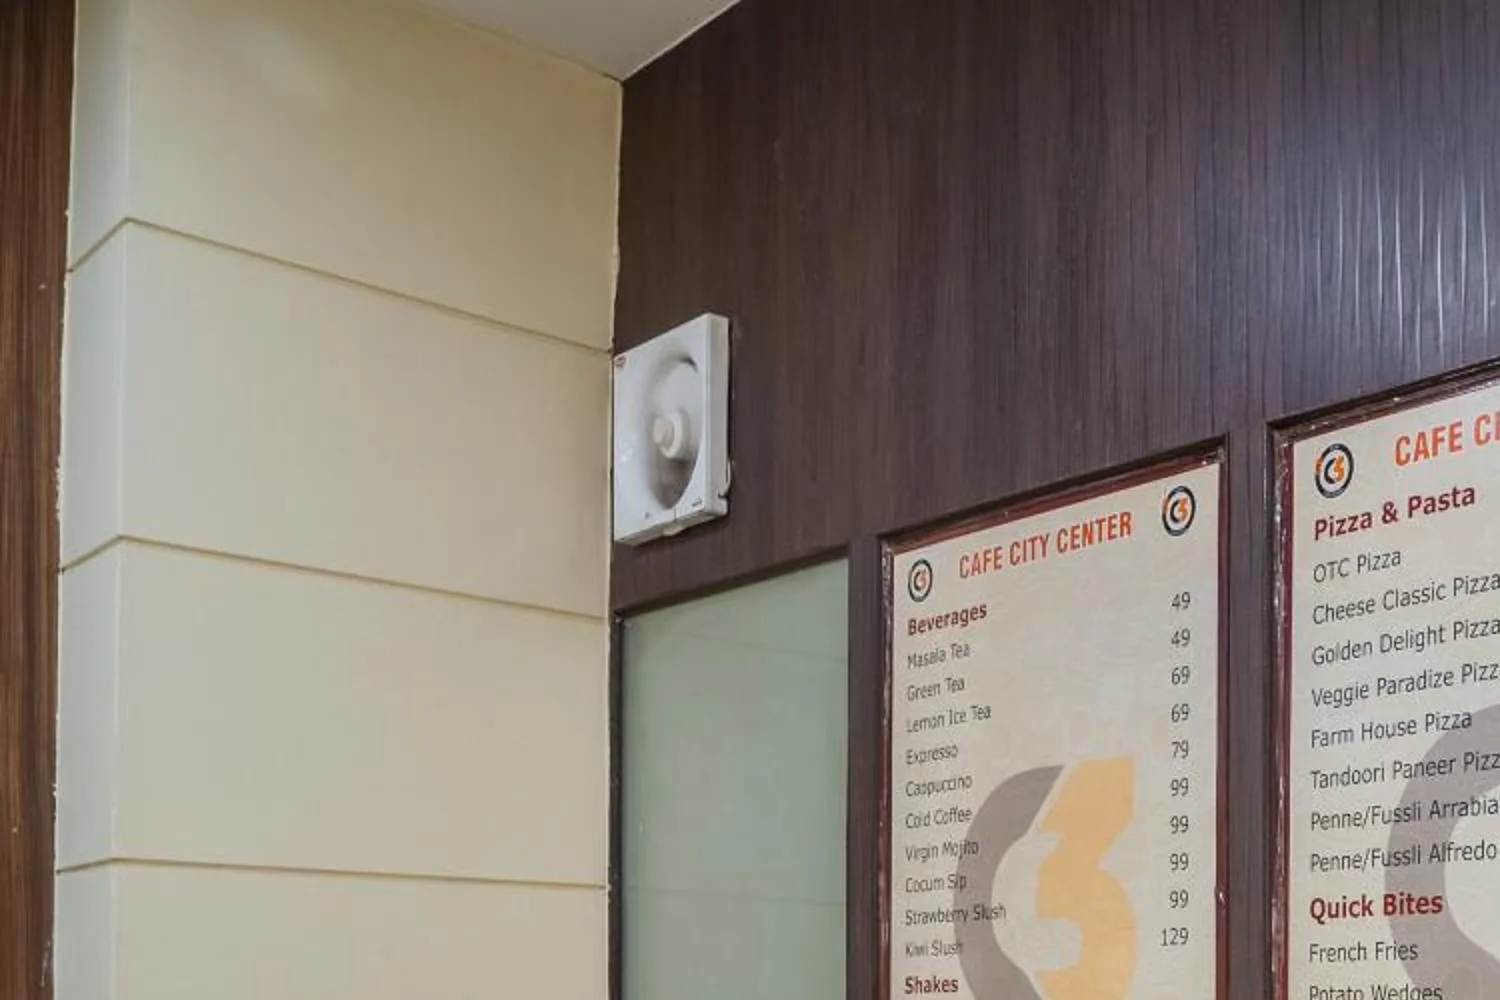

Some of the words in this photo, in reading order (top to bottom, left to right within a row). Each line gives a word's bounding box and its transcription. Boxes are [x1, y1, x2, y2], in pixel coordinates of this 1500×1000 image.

[1395, 420, 1462, 465] CAFE
[1314, 511, 1372, 540] Pizza
[1381, 501, 1398, 524] &
[1408, 486, 1474, 518] Pasta
[959, 545, 1002, 578] CAFE
[1009, 533, 1049, 565] CITY
[1056, 511, 1131, 553] CENTER
[1313, 557, 1349, 583] OTC
[1357, 550, 1400, 574] Pizza
[1312, 598, 1376, 624] Cheese
[1382, 581, 1446, 610] Classic
[1453, 573, 1500, 596] Pizza
[909, 604, 986, 635] Beverages
[1171, 627, 1190, 647] 49
[1171, 665, 1190, 685] 69
[1311, 728, 1353, 748] Farm
[1361, 719, 1416, 741] House
[1425, 711, 1471, 732] Pizza
[1171, 739, 1188, 759] 79
[1169, 777, 1188, 796] 99
[1309, 763, 1384, 789] Tandoori
[1392, 758, 1456, 779] Paneer
[1170, 815, 1188, 834] 99
[1311, 801, 1420, 830] Penne/Fussli
[1169, 852, 1188, 871] 99
[1169, 889, 1188, 908] 99
[1309, 893, 1373, 924] Quick
[1383, 892, 1442, 915] Bites
[905, 975, 958, 994] Shakes
